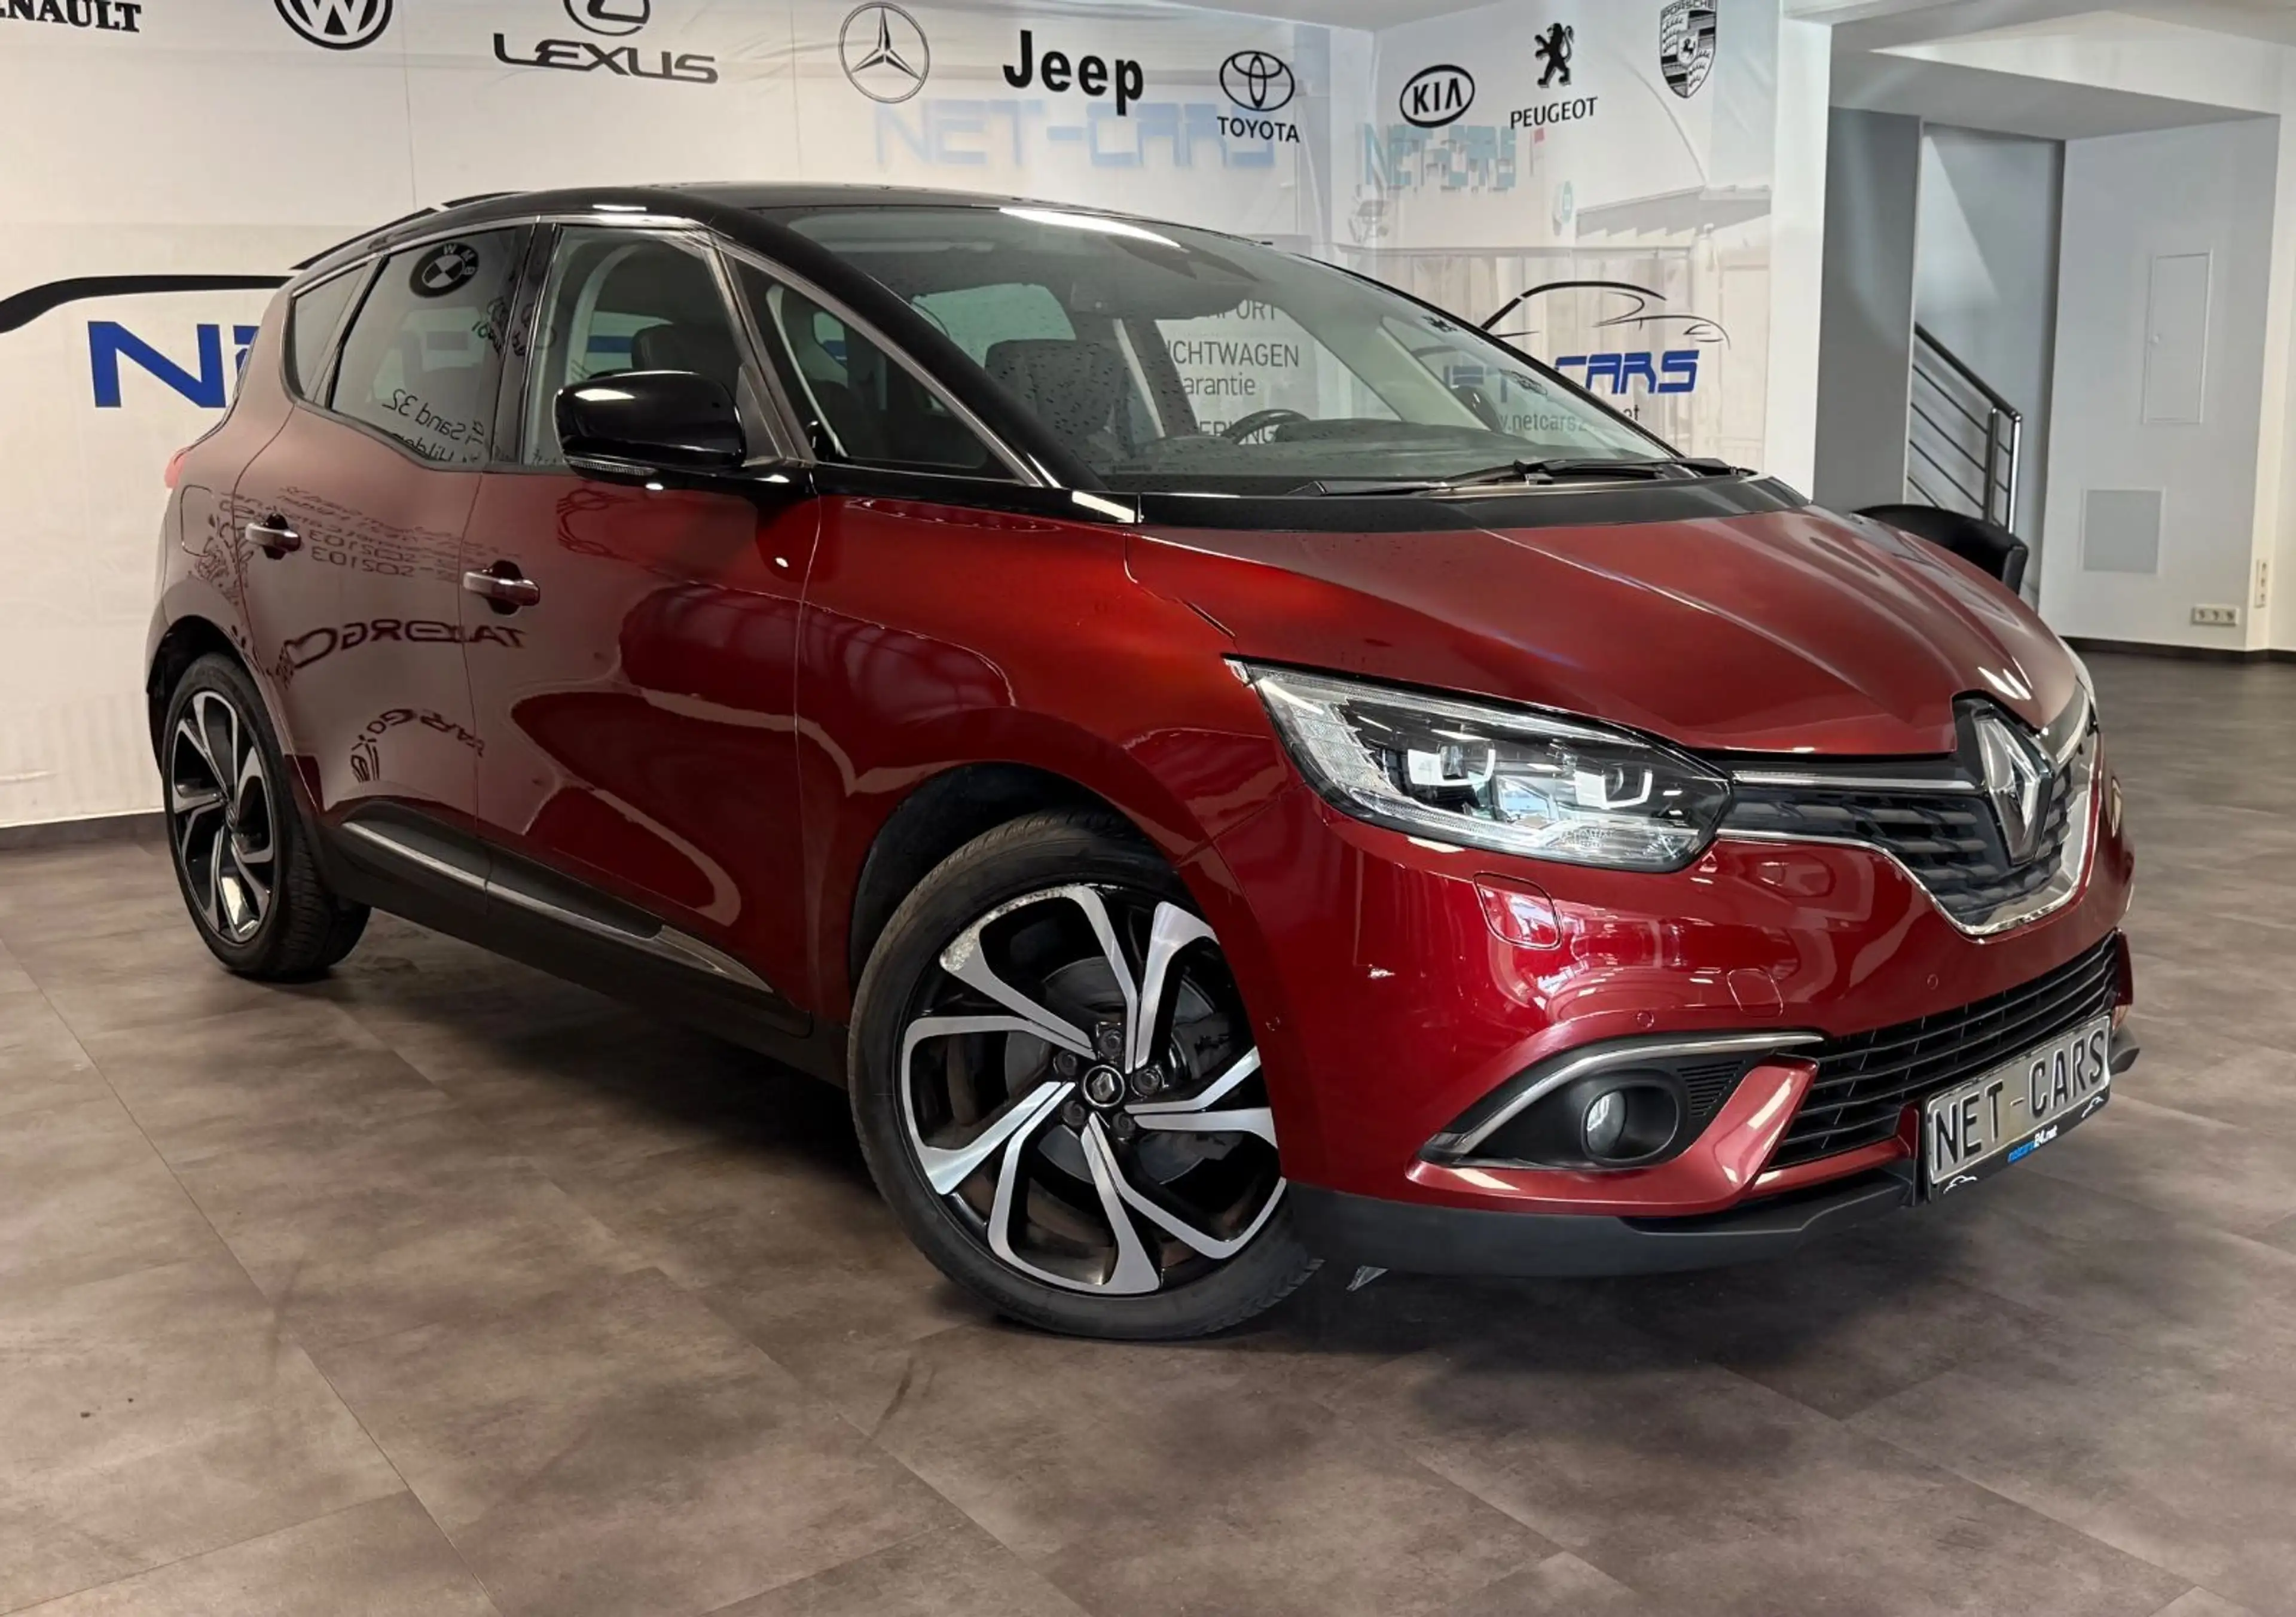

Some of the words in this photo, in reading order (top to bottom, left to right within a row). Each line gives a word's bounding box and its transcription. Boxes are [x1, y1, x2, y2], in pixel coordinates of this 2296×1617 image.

[493, 33, 718, 83] LEXUS
[1003, 29, 1144, 116] Jeep
[1413, 77, 1463, 115] KIA
[1510, 97, 1598, 130] PEUGEOT
[1217, 116, 1300, 143] TOYOTA
